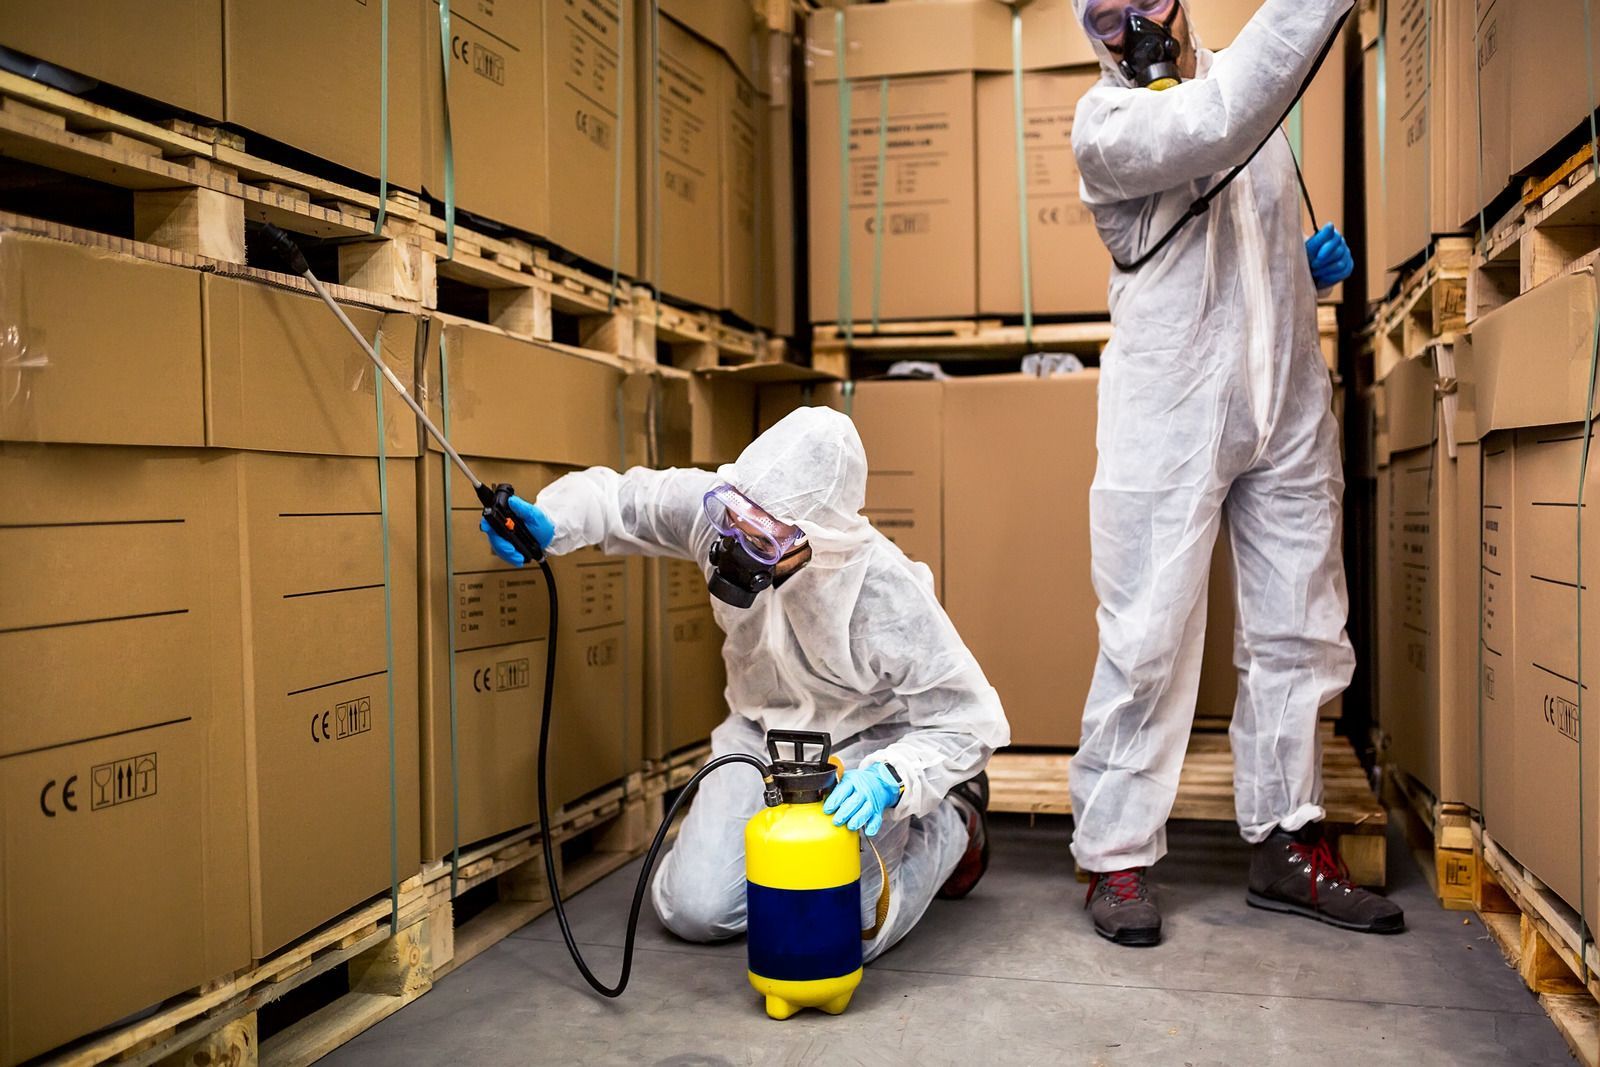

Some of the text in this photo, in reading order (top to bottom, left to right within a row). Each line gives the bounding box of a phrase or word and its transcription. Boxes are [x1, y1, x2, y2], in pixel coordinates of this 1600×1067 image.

[474, 667, 491, 693] CE
[1543, 694, 1555, 726] CE
[311, 711, 331, 743] CE
[40, 775, 78, 818] CE
